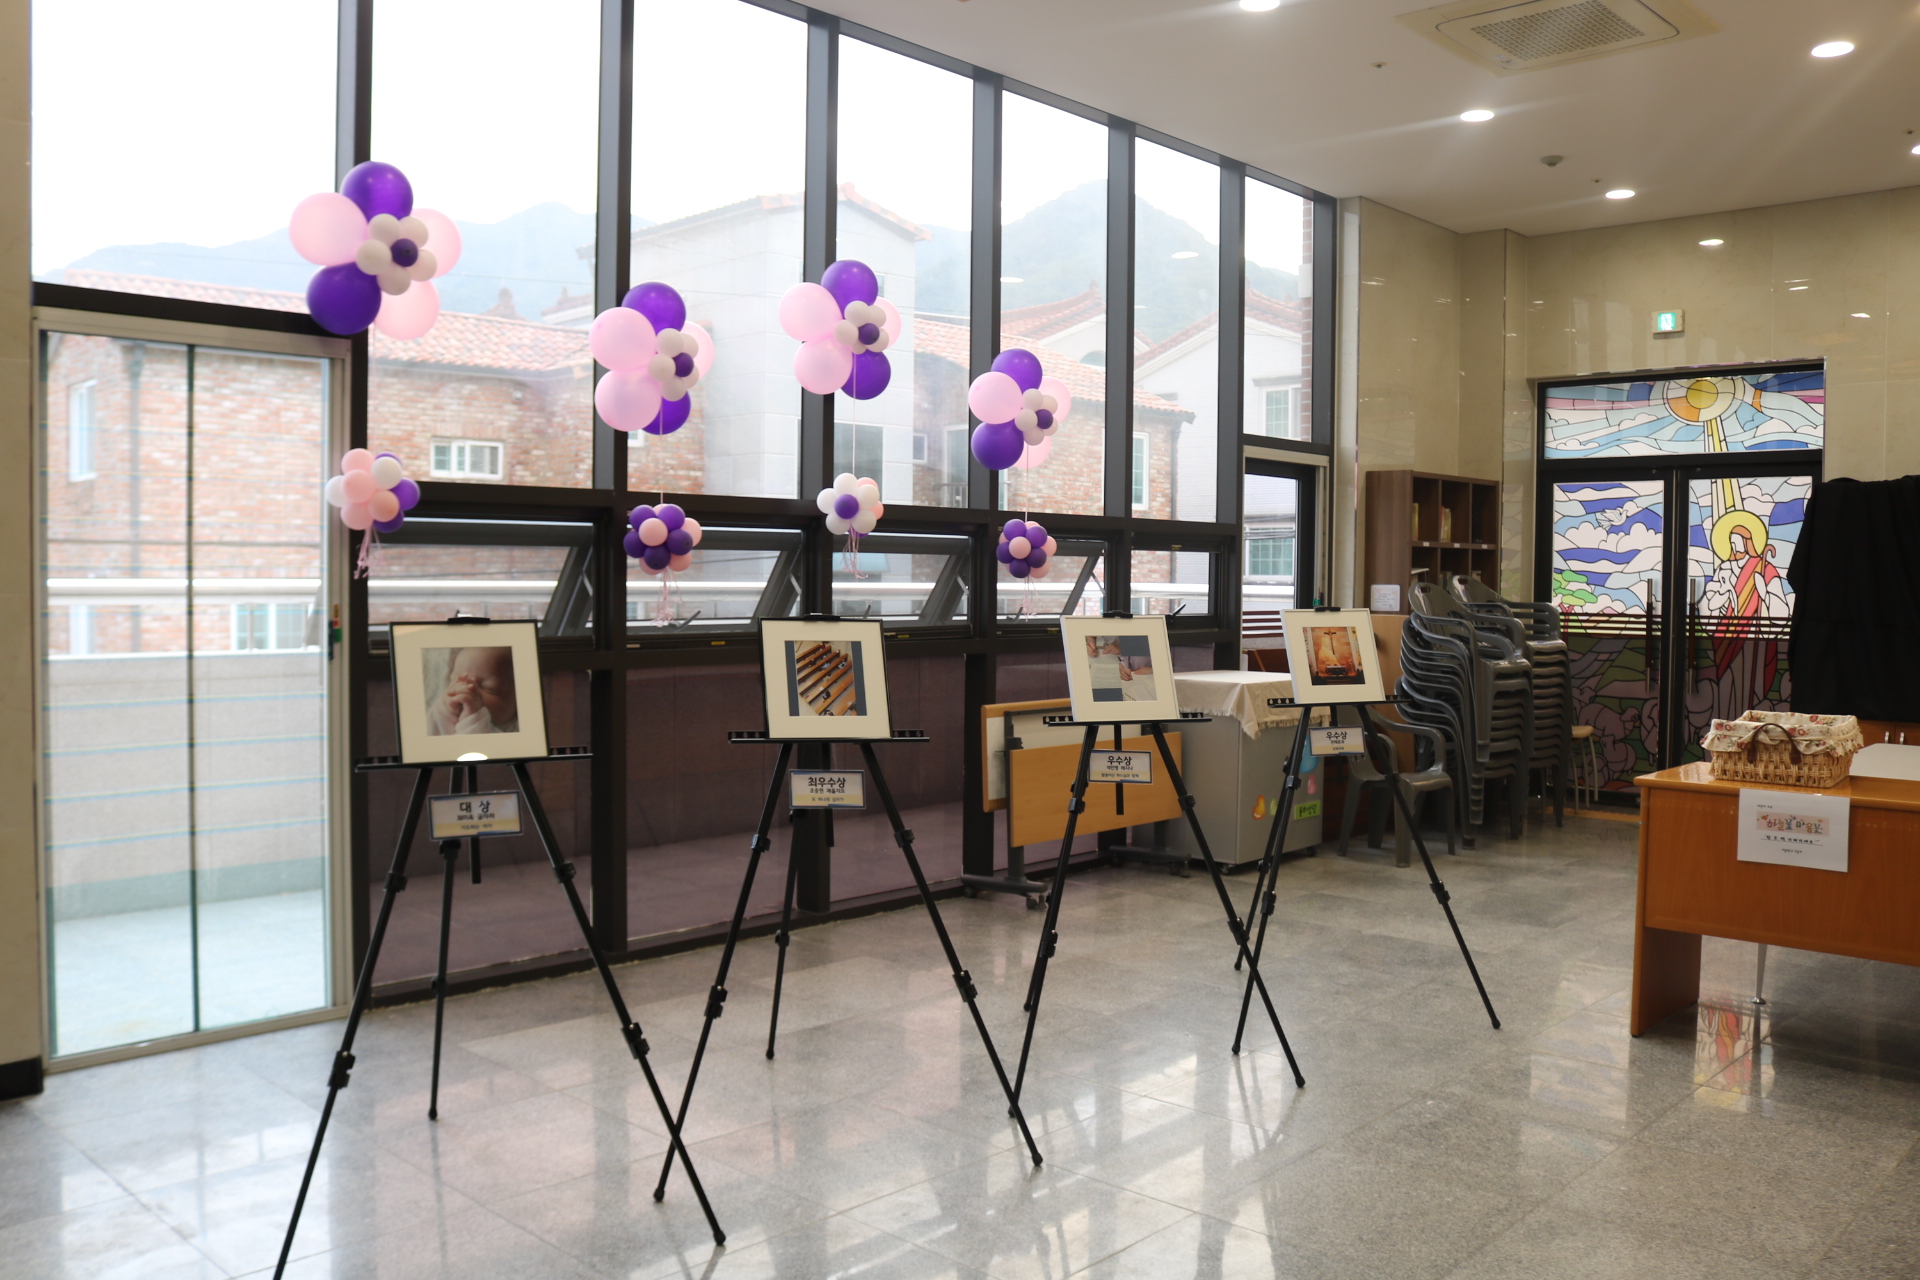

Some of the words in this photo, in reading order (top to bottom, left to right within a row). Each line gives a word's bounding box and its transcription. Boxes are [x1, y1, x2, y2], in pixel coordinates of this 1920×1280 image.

[1326, 731, 1348, 740] 우수상
[1107, 755, 1132, 766] 우수상
[808, 776, 847, 789] 최우수상
[459, 801, 472, 813] 대
[478, 799, 491, 814] 상
[1766, 818, 1793, 831] 하늘꽃
